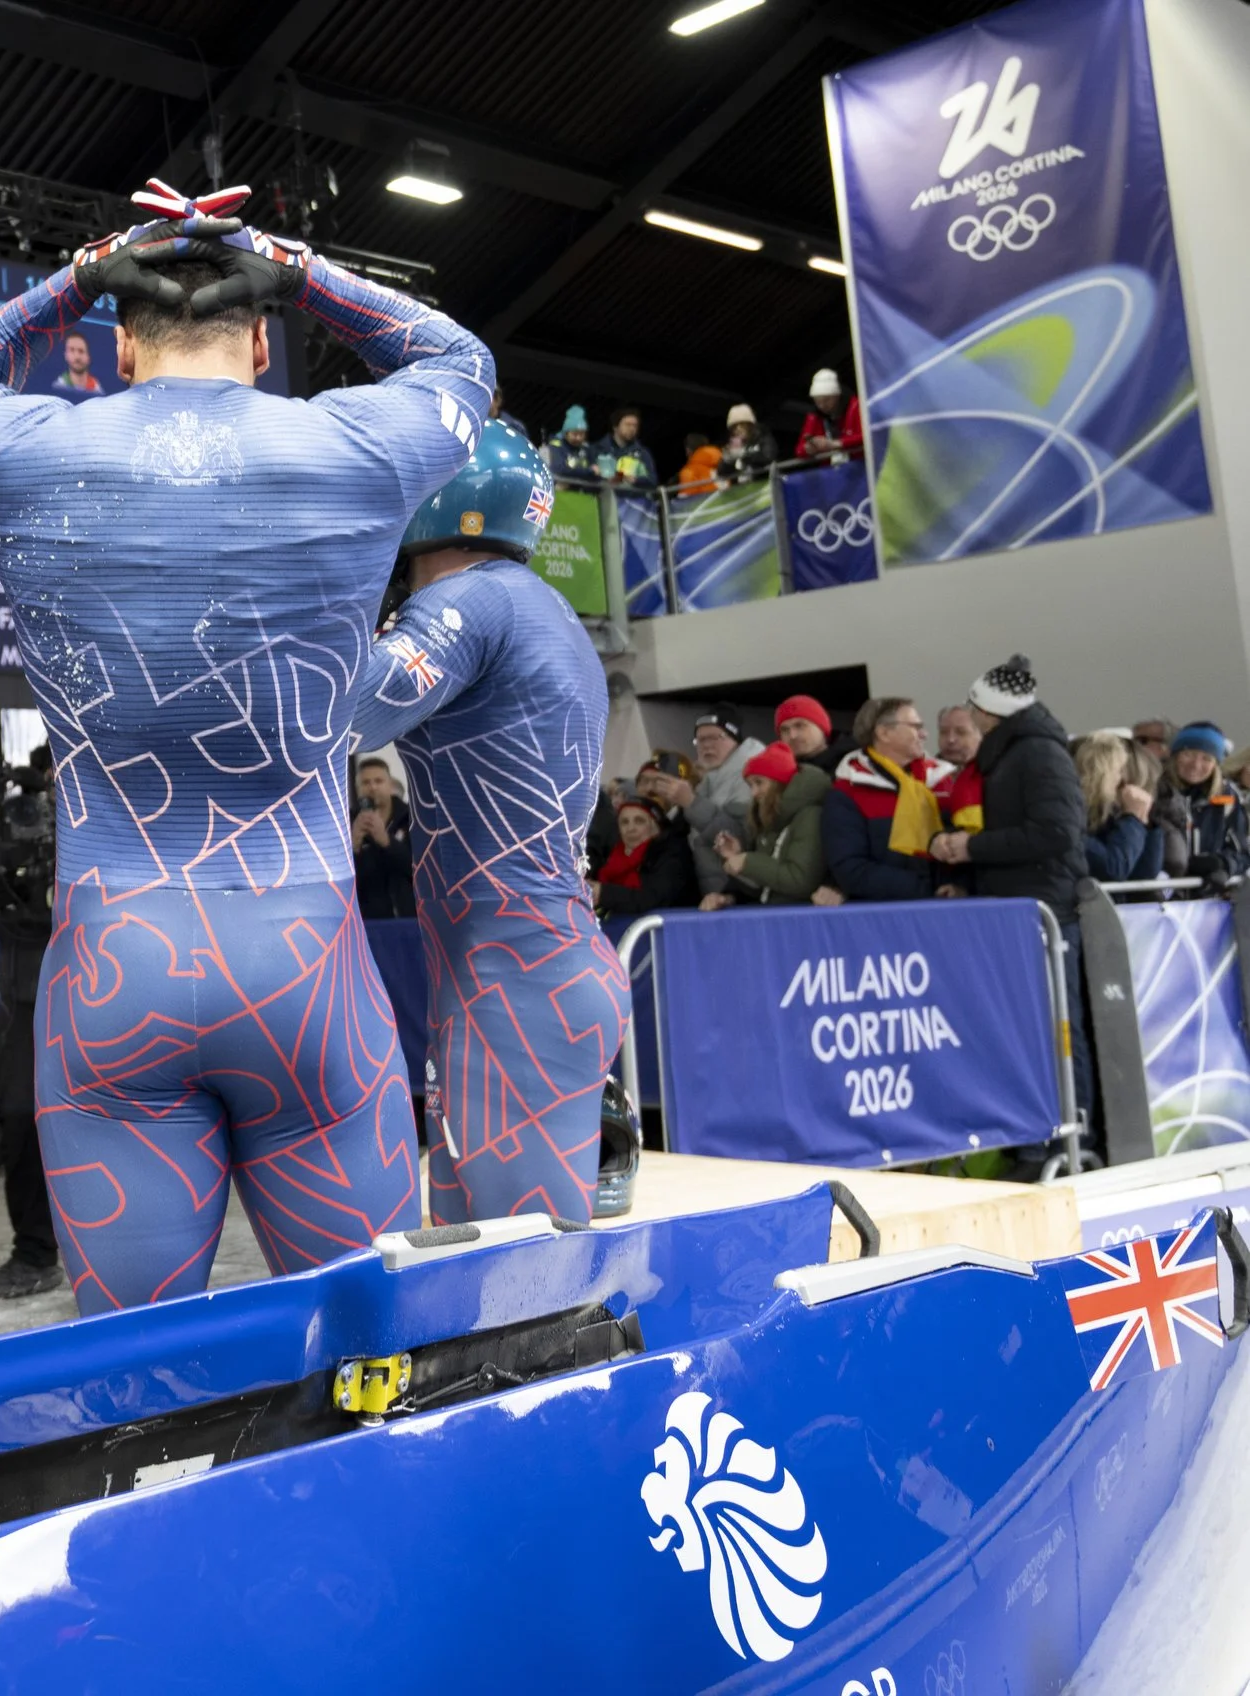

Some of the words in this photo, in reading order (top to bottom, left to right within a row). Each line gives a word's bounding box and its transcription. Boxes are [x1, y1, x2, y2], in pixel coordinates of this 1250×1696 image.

[910, 171, 993, 210] MILANO
[995, 144, 1085, 183] CORTINA
[976, 180, 1018, 206] 2026
[542, 523, 579, 541] LANO
[535, 541, 592, 563] CORTINA
[545, 559, 573, 577] 2026
[780, 952, 929, 1008] MILANO
[811, 1006, 961, 1063] CORTINA
[845, 1065, 913, 1117] 2026
